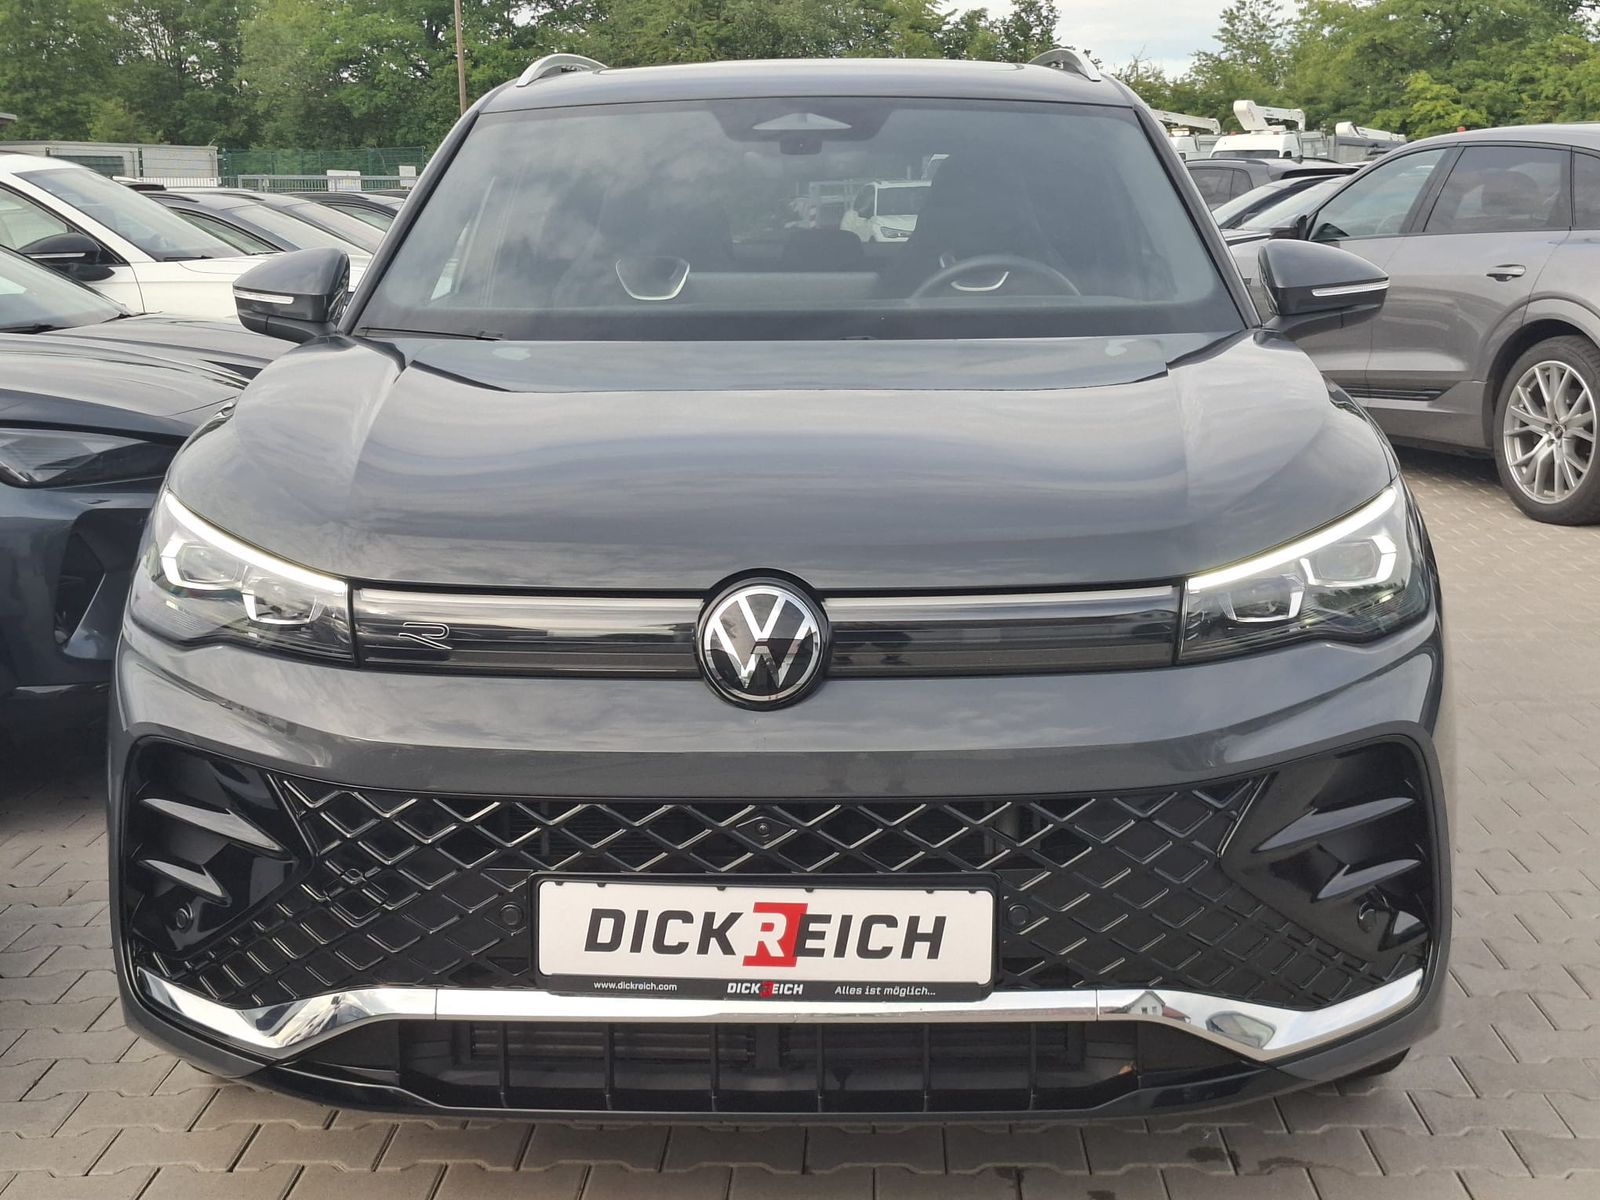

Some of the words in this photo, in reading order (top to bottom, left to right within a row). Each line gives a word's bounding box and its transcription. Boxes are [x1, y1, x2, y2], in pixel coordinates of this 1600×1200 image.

[584, 902, 947, 967] DICKREICH
[593, 981, 678, 992] www.dickreich.com
[834, 985, 862, 996] Alles
[865, 985, 881, 996] ist
